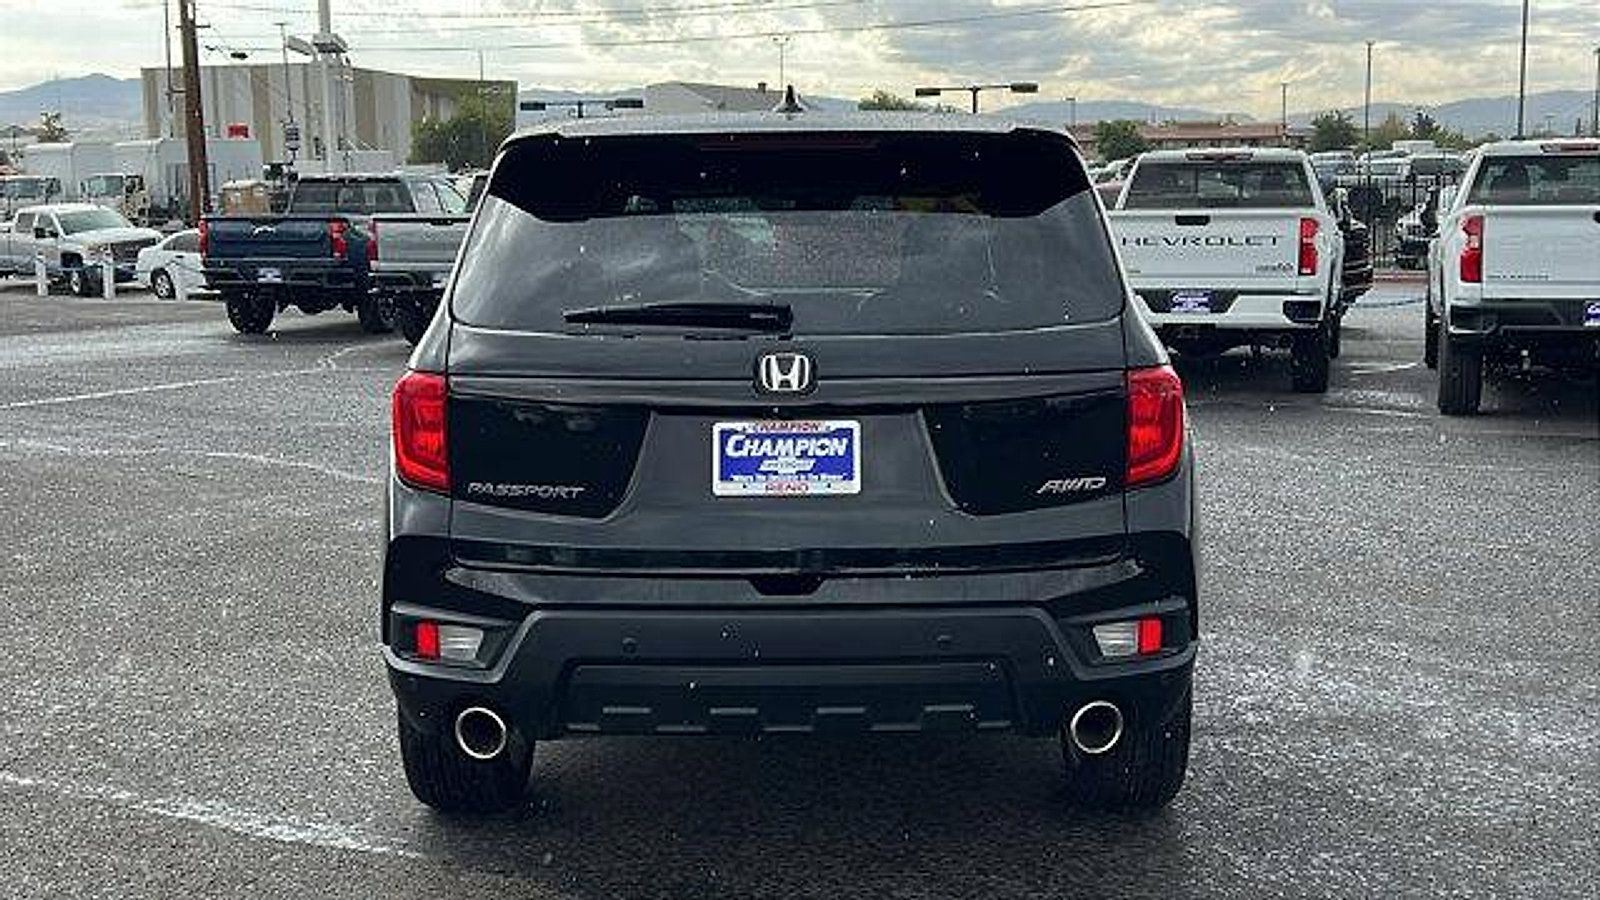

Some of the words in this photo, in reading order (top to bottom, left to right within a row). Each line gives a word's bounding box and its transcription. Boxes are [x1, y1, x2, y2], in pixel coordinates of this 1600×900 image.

[1121, 234, 1284, 247] HEVROLET
[725, 435, 848, 457] CHAMPION
[467, 482, 586, 499] PASSPORT
[1036, 477, 1106, 495] AWD
